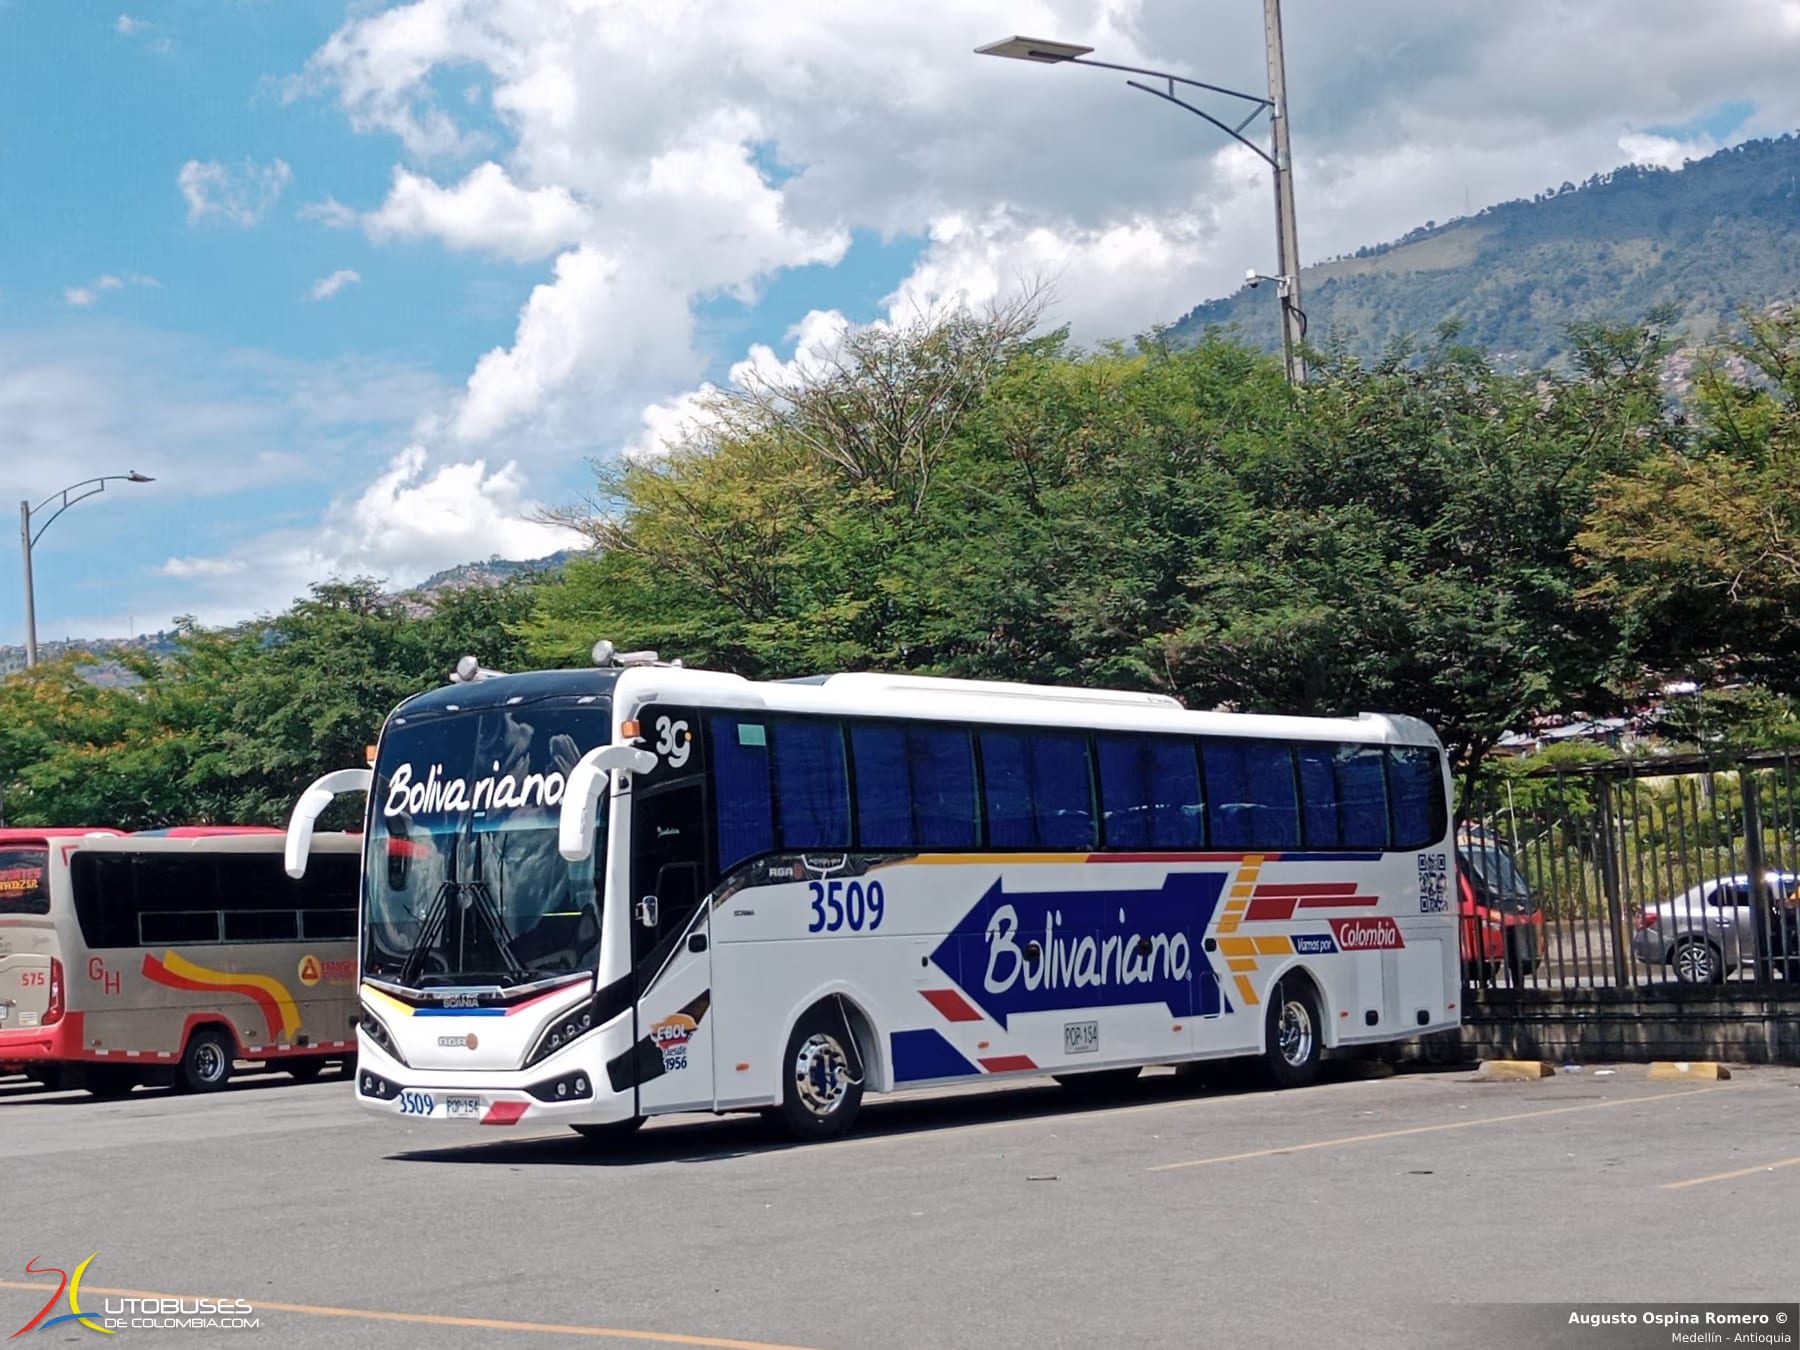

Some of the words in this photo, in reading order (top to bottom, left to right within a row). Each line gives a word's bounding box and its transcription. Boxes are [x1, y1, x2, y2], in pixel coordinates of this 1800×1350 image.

[384, 761, 565, 816] Bolivariano
[808, 881, 884, 933] 3509
[1297, 937, 1320, 952] Vamos
[1320, 939, 1332, 953] por
[1340, 920, 1396, 947] Colombia
[984, 903, 1188, 994] Bolivariano
[22, 972, 45, 986] 575
[443, 999, 479, 1008] SCANIA
[665, 1056, 687, 1070] 1956
[400, 1092, 434, 1115] 3509
